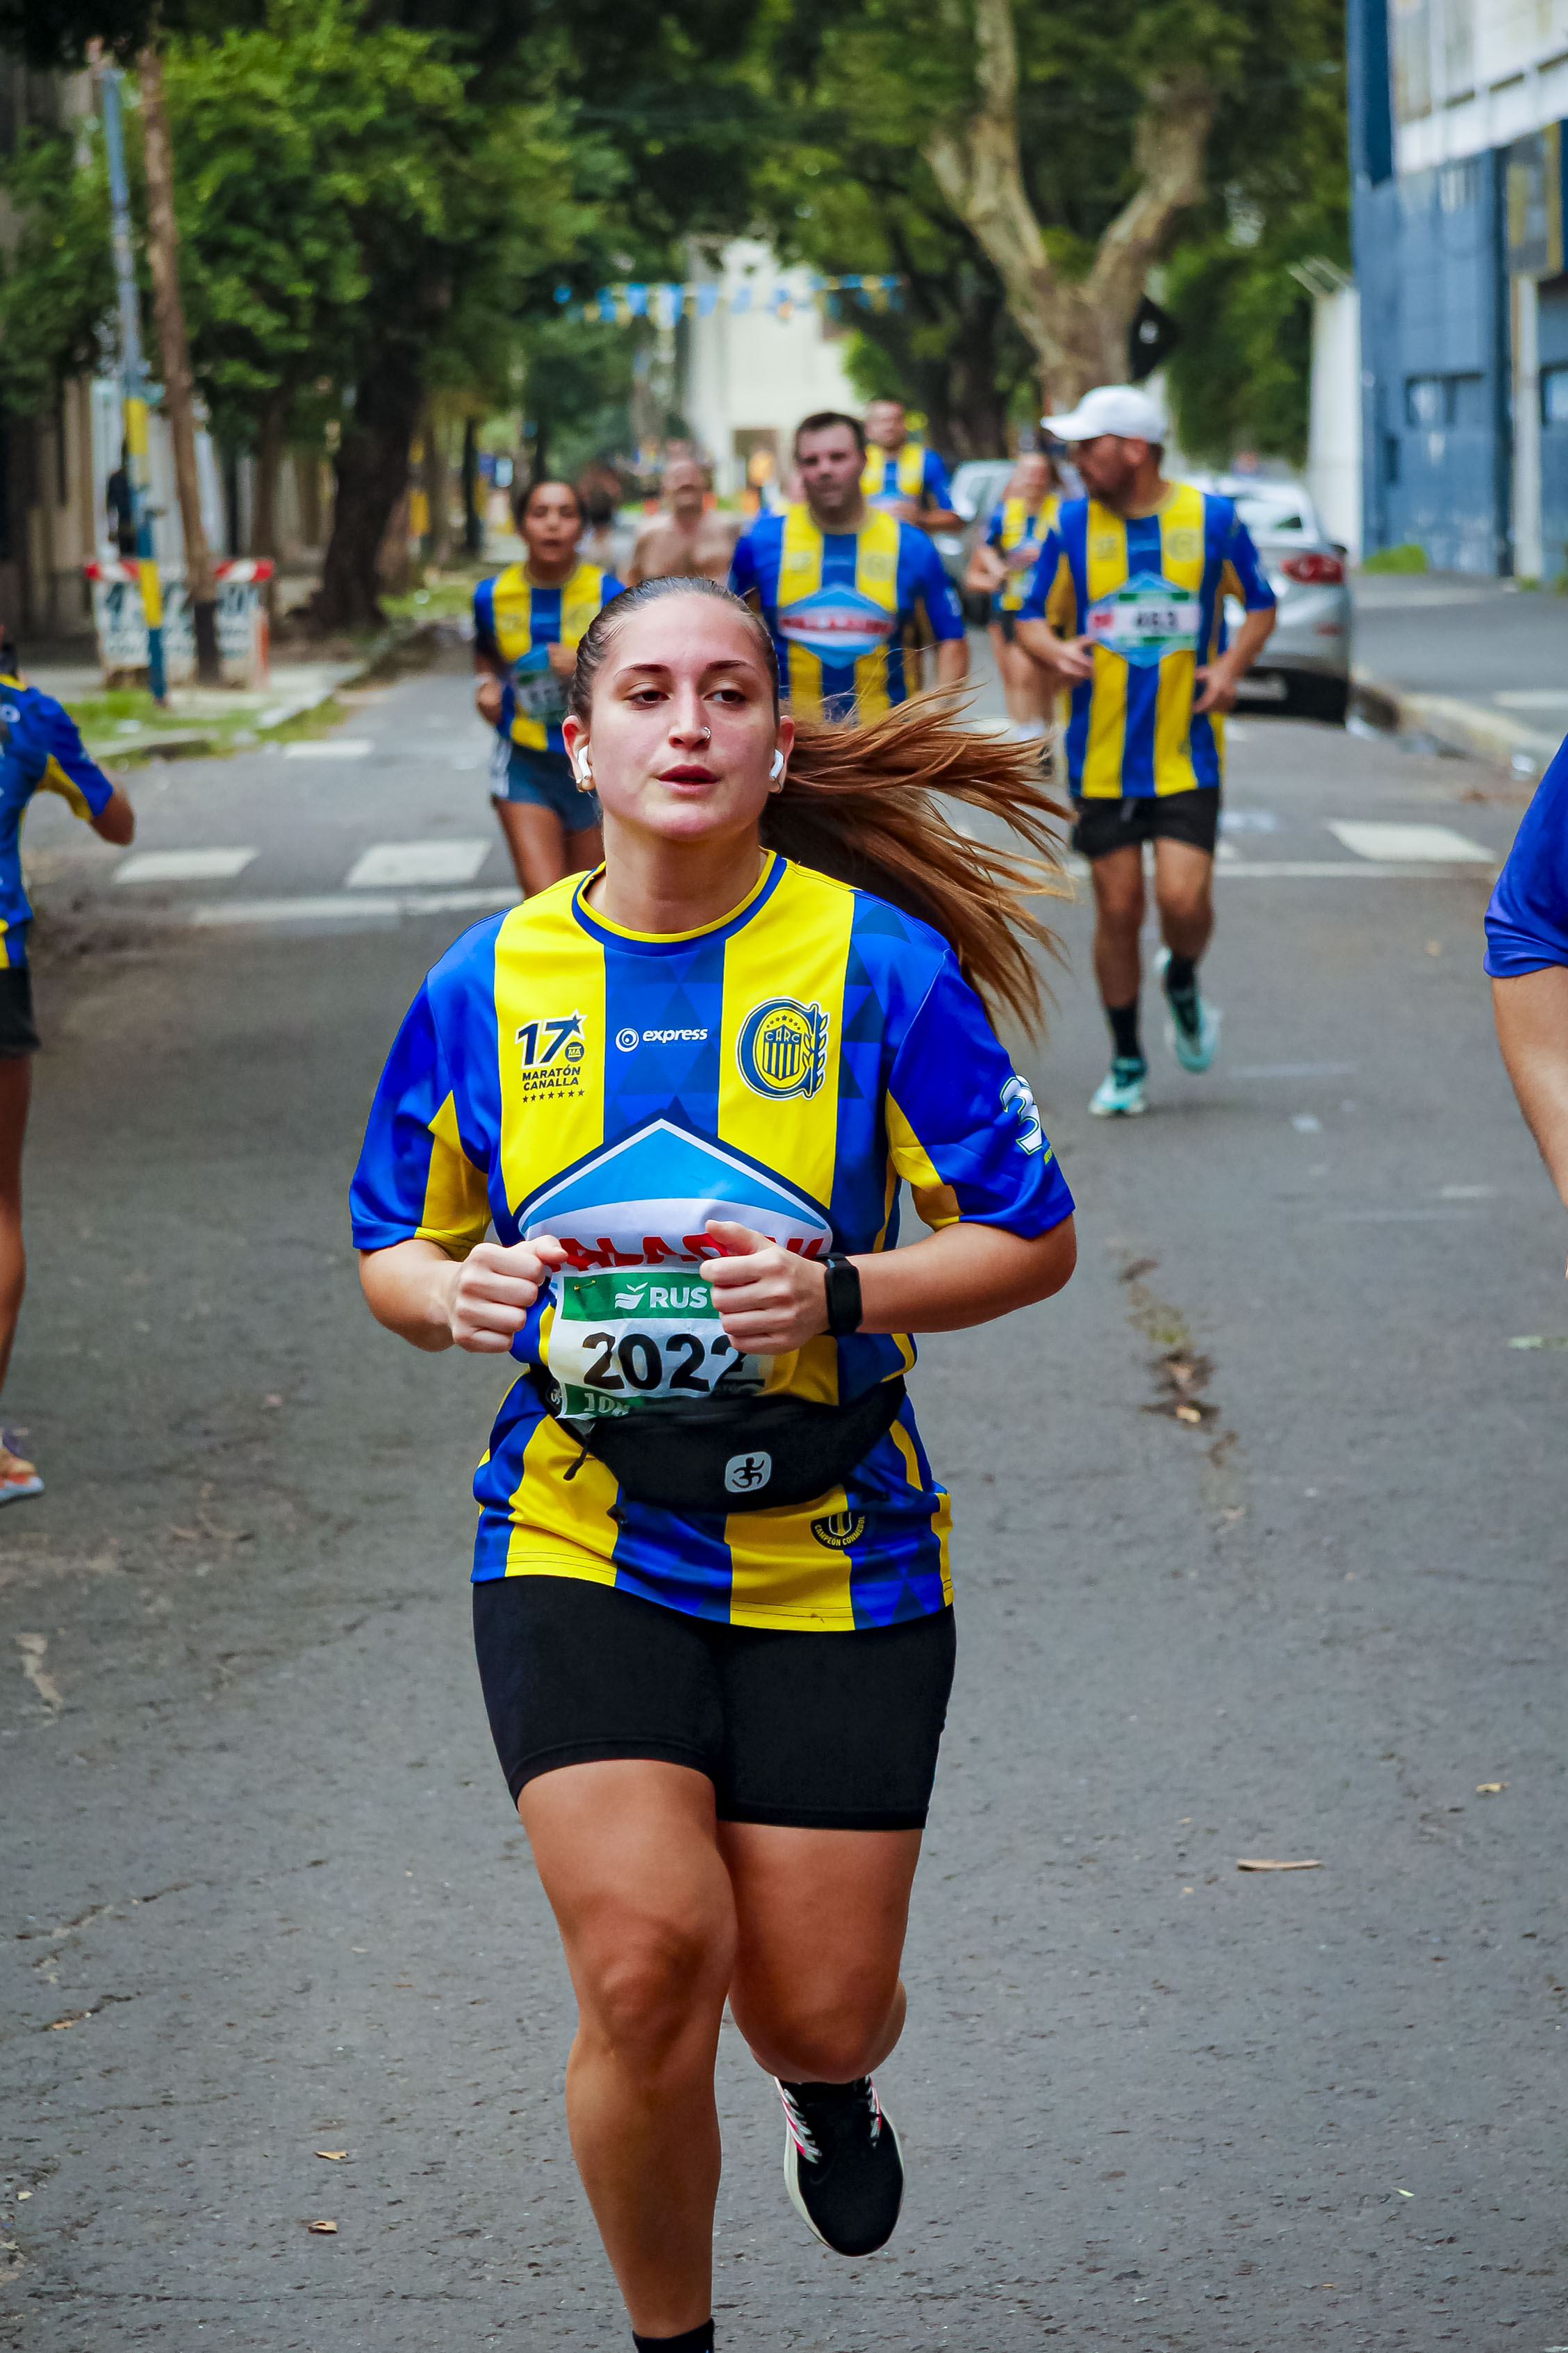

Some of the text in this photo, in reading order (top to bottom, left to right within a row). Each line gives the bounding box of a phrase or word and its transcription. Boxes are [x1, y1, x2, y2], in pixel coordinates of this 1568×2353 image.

[516, 1011, 584, 1068] 17
[643, 1028, 709, 1044] express
[765, 1027, 801, 1043] CARC
[522, 1065, 581, 1081] MARATÓN
[523, 1077, 579, 1091] CANALLA
[649, 1287, 709, 1309] RUS
[581, 1331, 745, 1391] 2022
